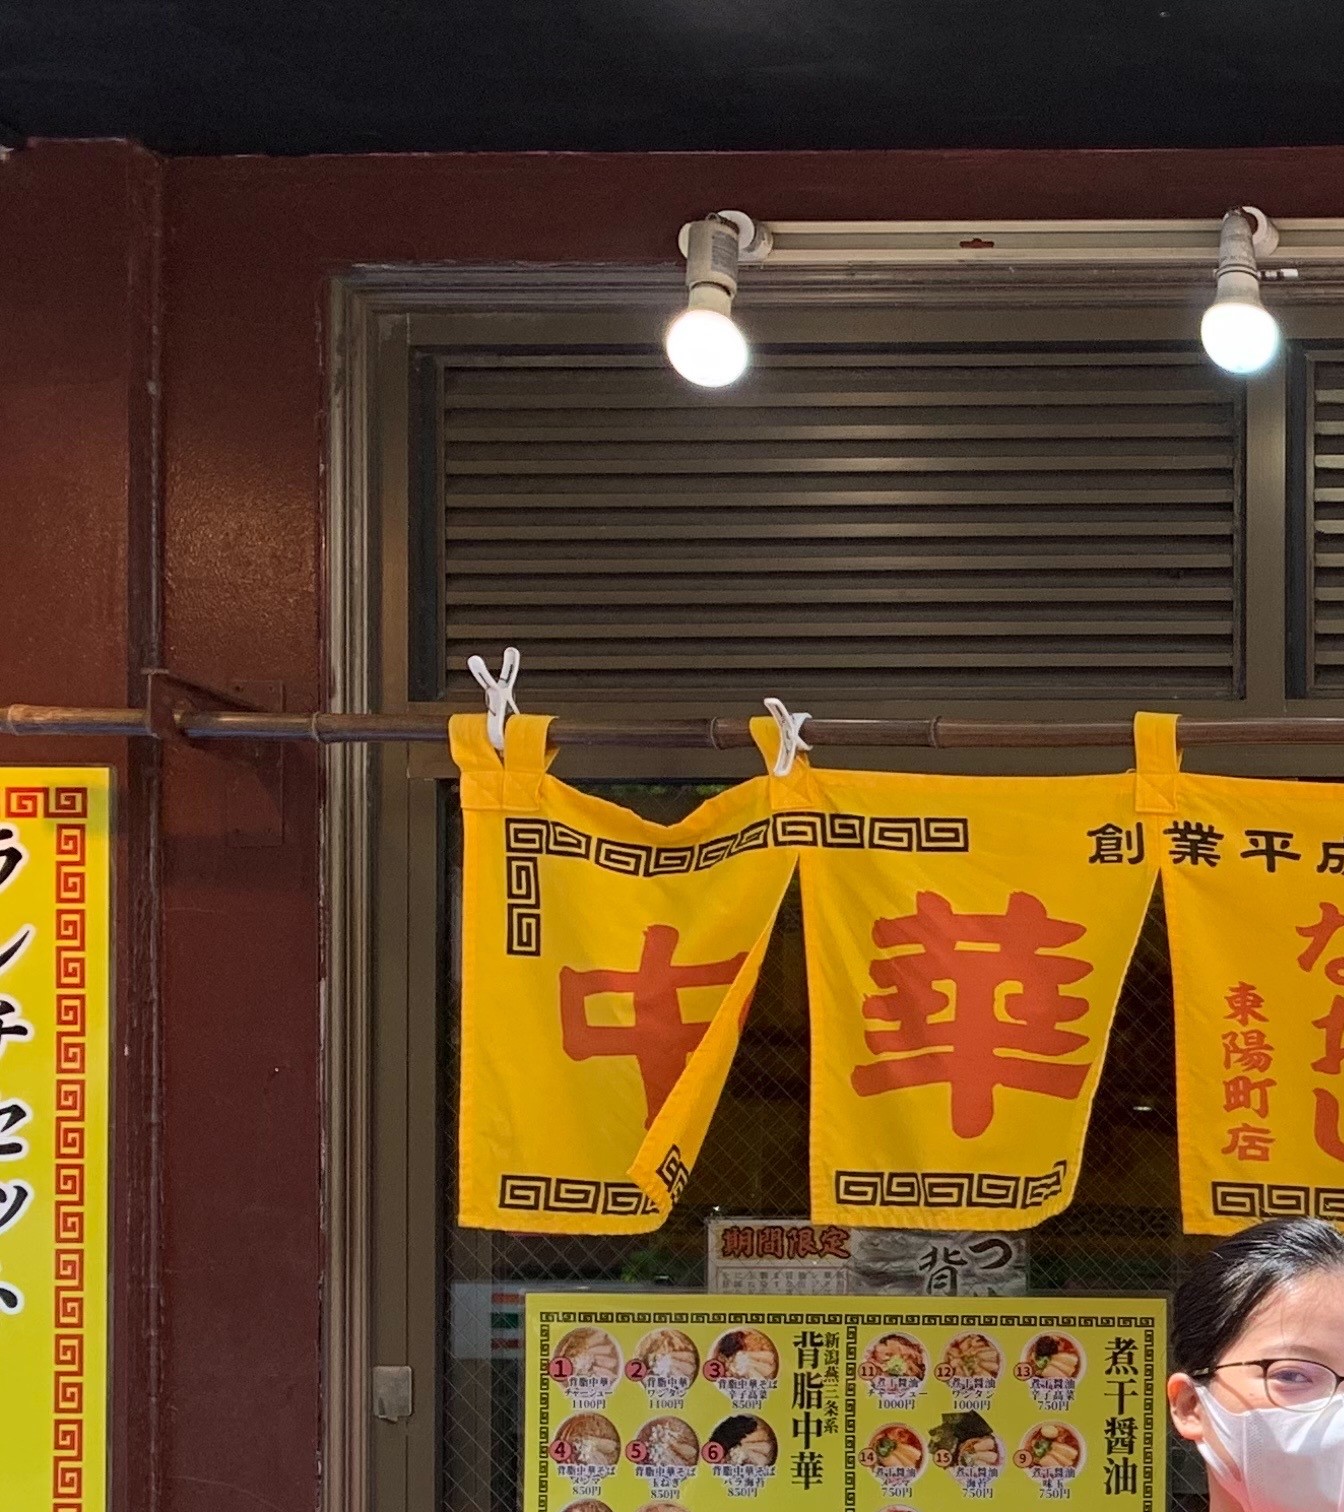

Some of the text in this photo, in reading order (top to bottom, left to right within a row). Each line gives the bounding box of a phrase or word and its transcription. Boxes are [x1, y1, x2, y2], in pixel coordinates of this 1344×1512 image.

[1220, 981, 1276, 1163] 東陽町店
[721, 1226, 851, 1259] 期間限定
[556, 1361, 567, 1376] 1
[632, 1363, 642, 1376] 2
[710, 1364, 720, 1377] 3
[862, 1366, 875, 1376] 11
[938, 1367, 952, 1377] 12
[1017, 1366, 1030, 1377] 13
[791, 1331, 824, 1490] 背脂中華
[1103, 1336, 1139, 1495] 煮干醤油
[556, 1444, 565, 1457] 4
[633, 1443, 640, 1457] 5
[708, 1444, 718, 1458] 6
[861, 1452, 873, 1462] 14
[936, 1452, 950, 1463] 15
[1019, 1453, 1026, 1463] 9
